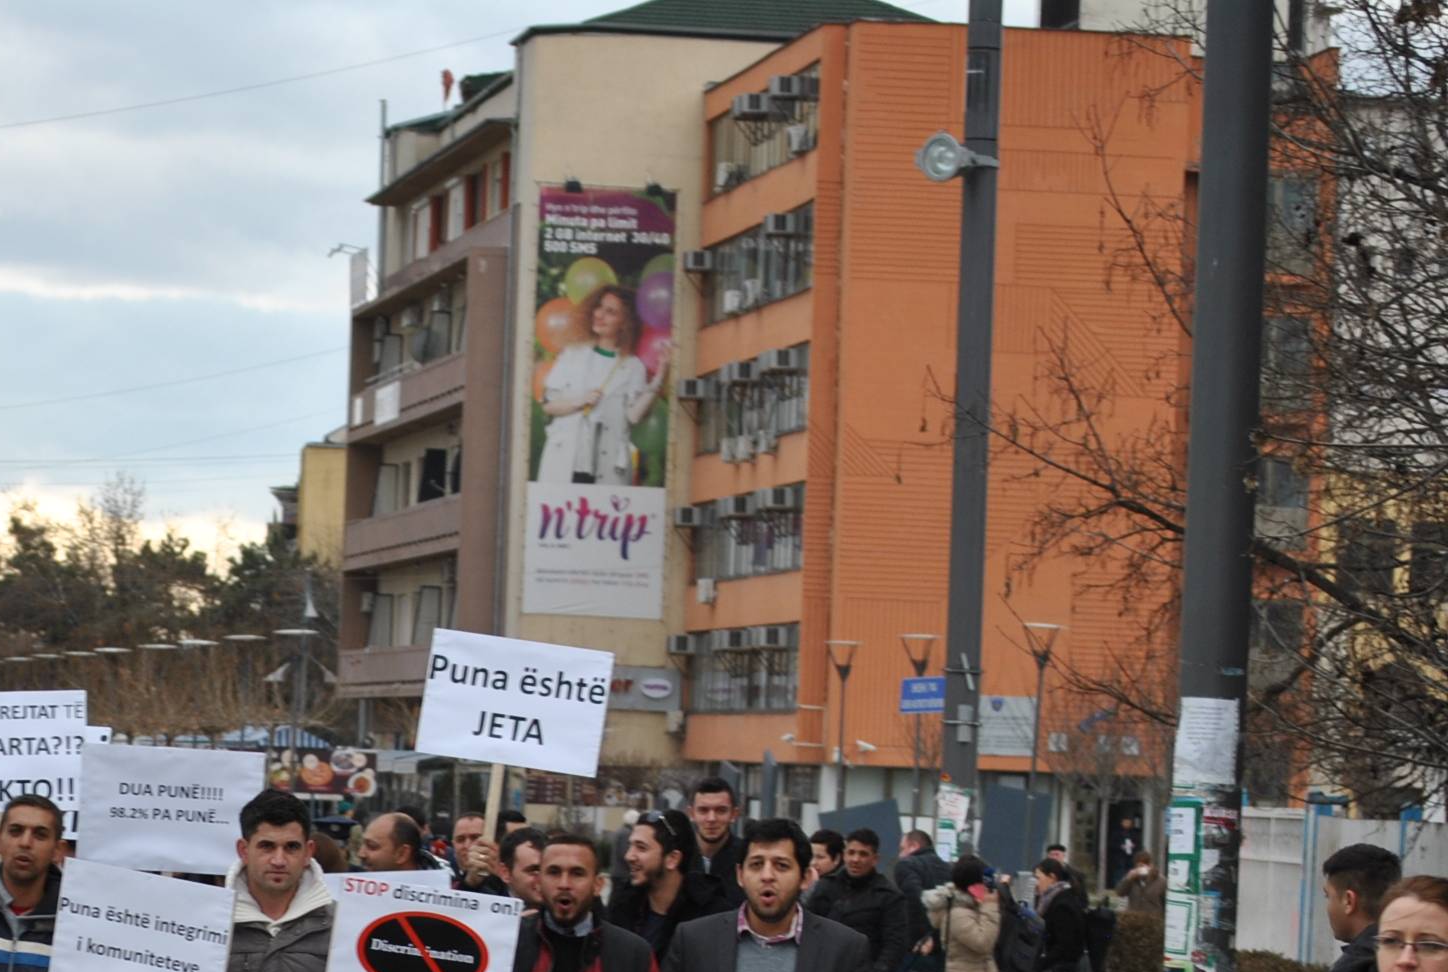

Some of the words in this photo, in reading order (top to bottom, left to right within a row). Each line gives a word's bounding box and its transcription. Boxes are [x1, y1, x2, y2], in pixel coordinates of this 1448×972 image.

[430, 654, 509, 691] Puna
[520, 667, 606, 704] është
[62, 701, 83, 720] TË
[472, 711, 544, 746] JETA
[119, 782, 153, 796] DUA
[157, 783, 224, 801] PUNË!!!!
[109, 806, 148, 820] 98.2%
[152, 808, 172, 821] PA
[344, 877, 390, 896] STOP
[59, 896, 101, 919] Puna
[105, 906, 151, 929] është
[154, 916, 229, 945] integrimi
[76, 936, 83, 951] i
